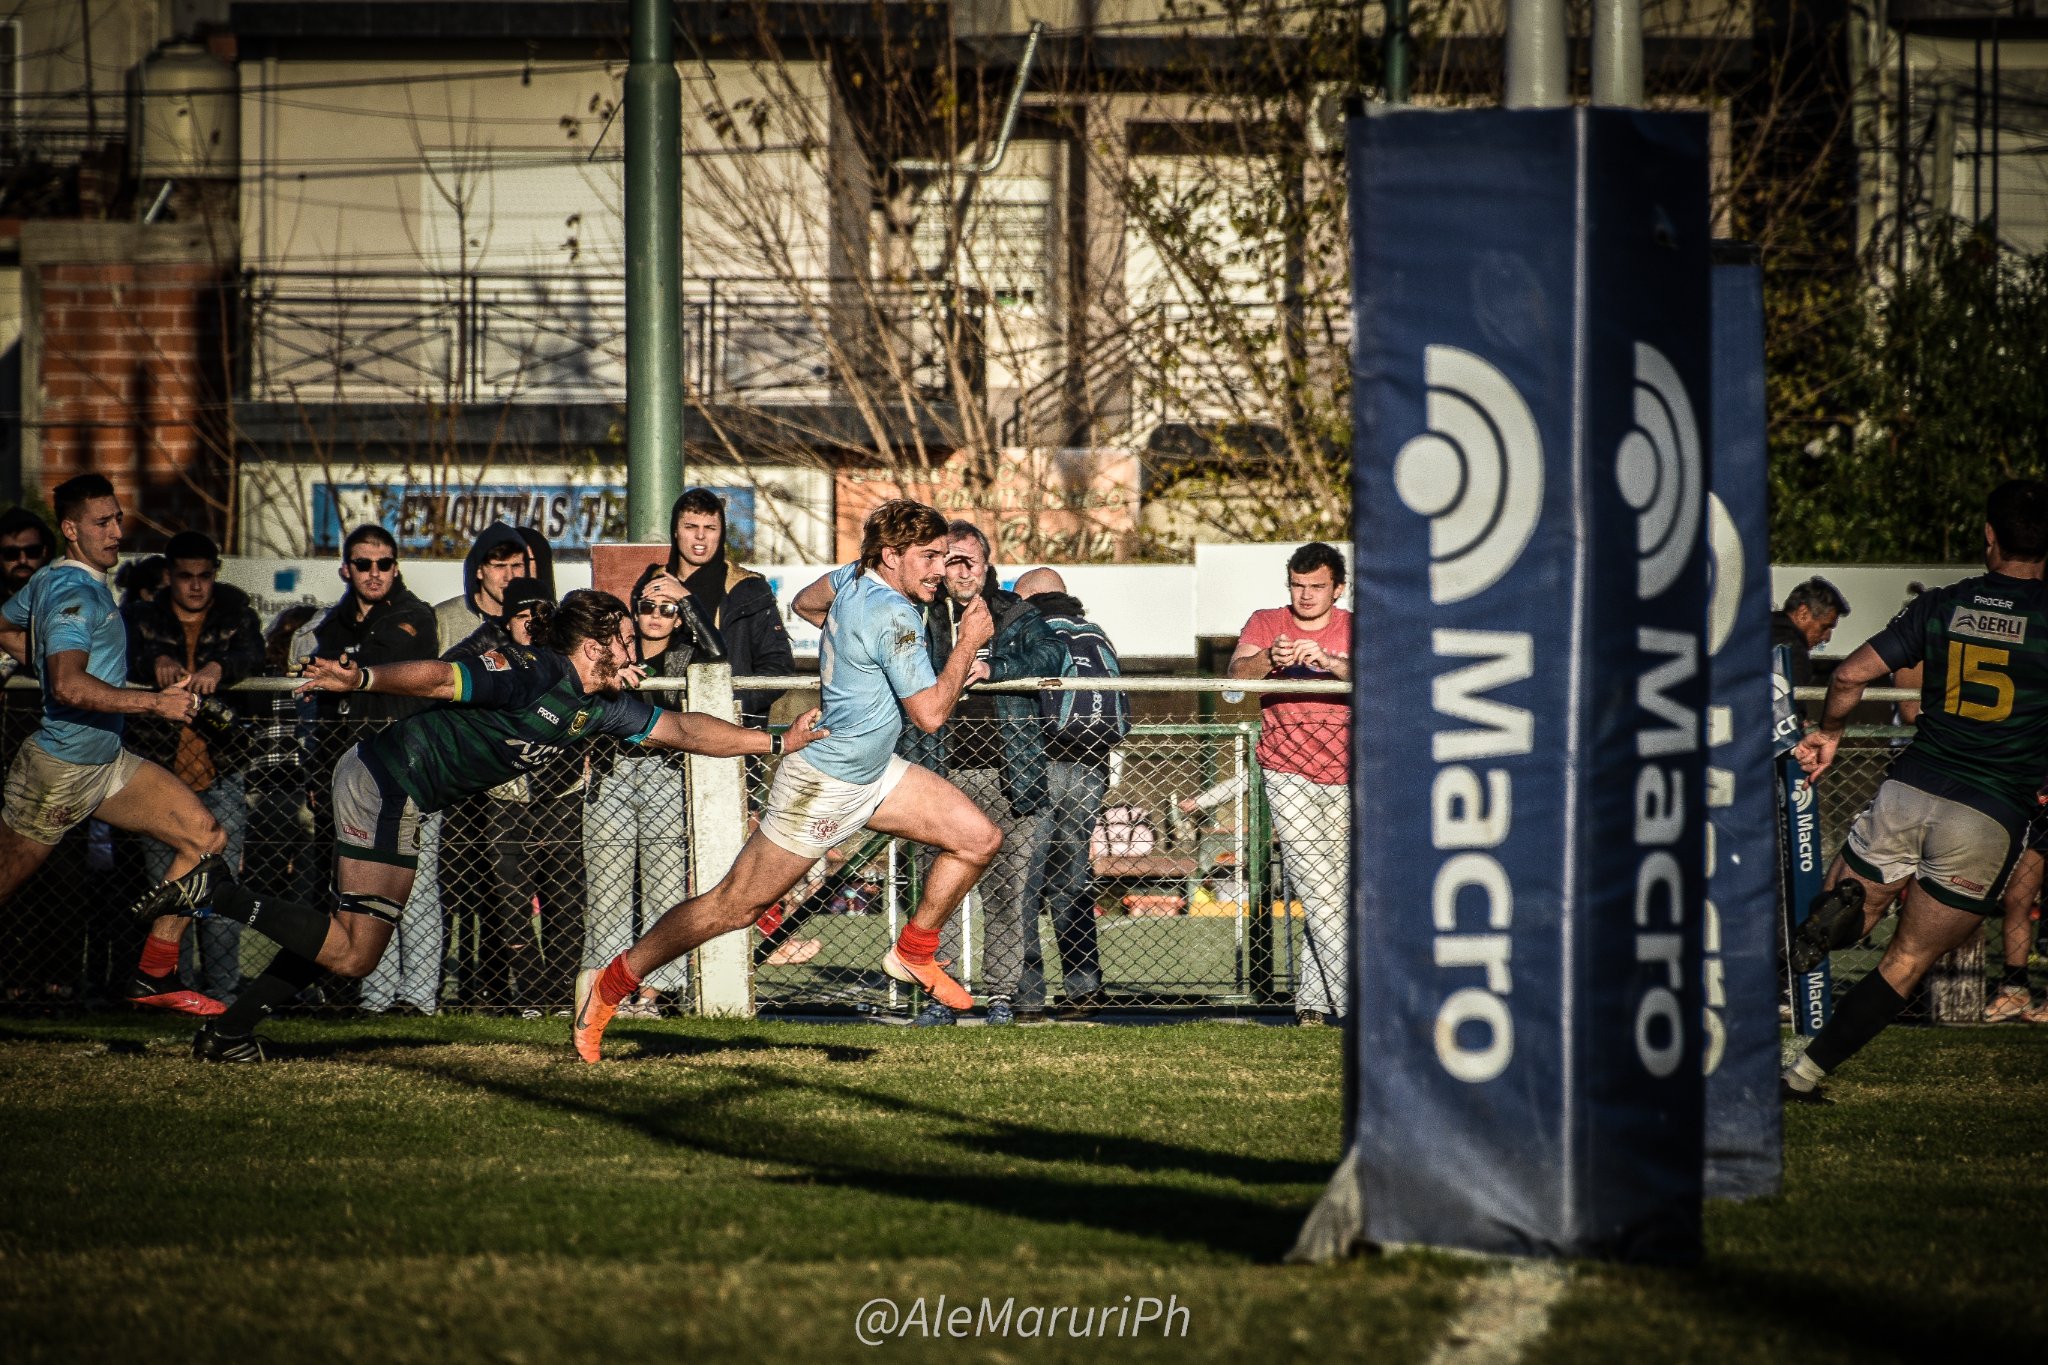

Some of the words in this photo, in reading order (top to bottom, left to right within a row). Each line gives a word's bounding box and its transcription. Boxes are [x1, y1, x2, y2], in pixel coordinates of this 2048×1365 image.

[1973, 595, 2014, 610] PROCER
[1977, 615, 2023, 635] GERLI
[1943, 640, 2016, 722] 15
[1430, 628, 1535, 1084] Macro
[1634, 627, 1699, 1079] Macro
[1797, 813, 1814, 872] Macro
[1807, 971, 1825, 1030] Macro
